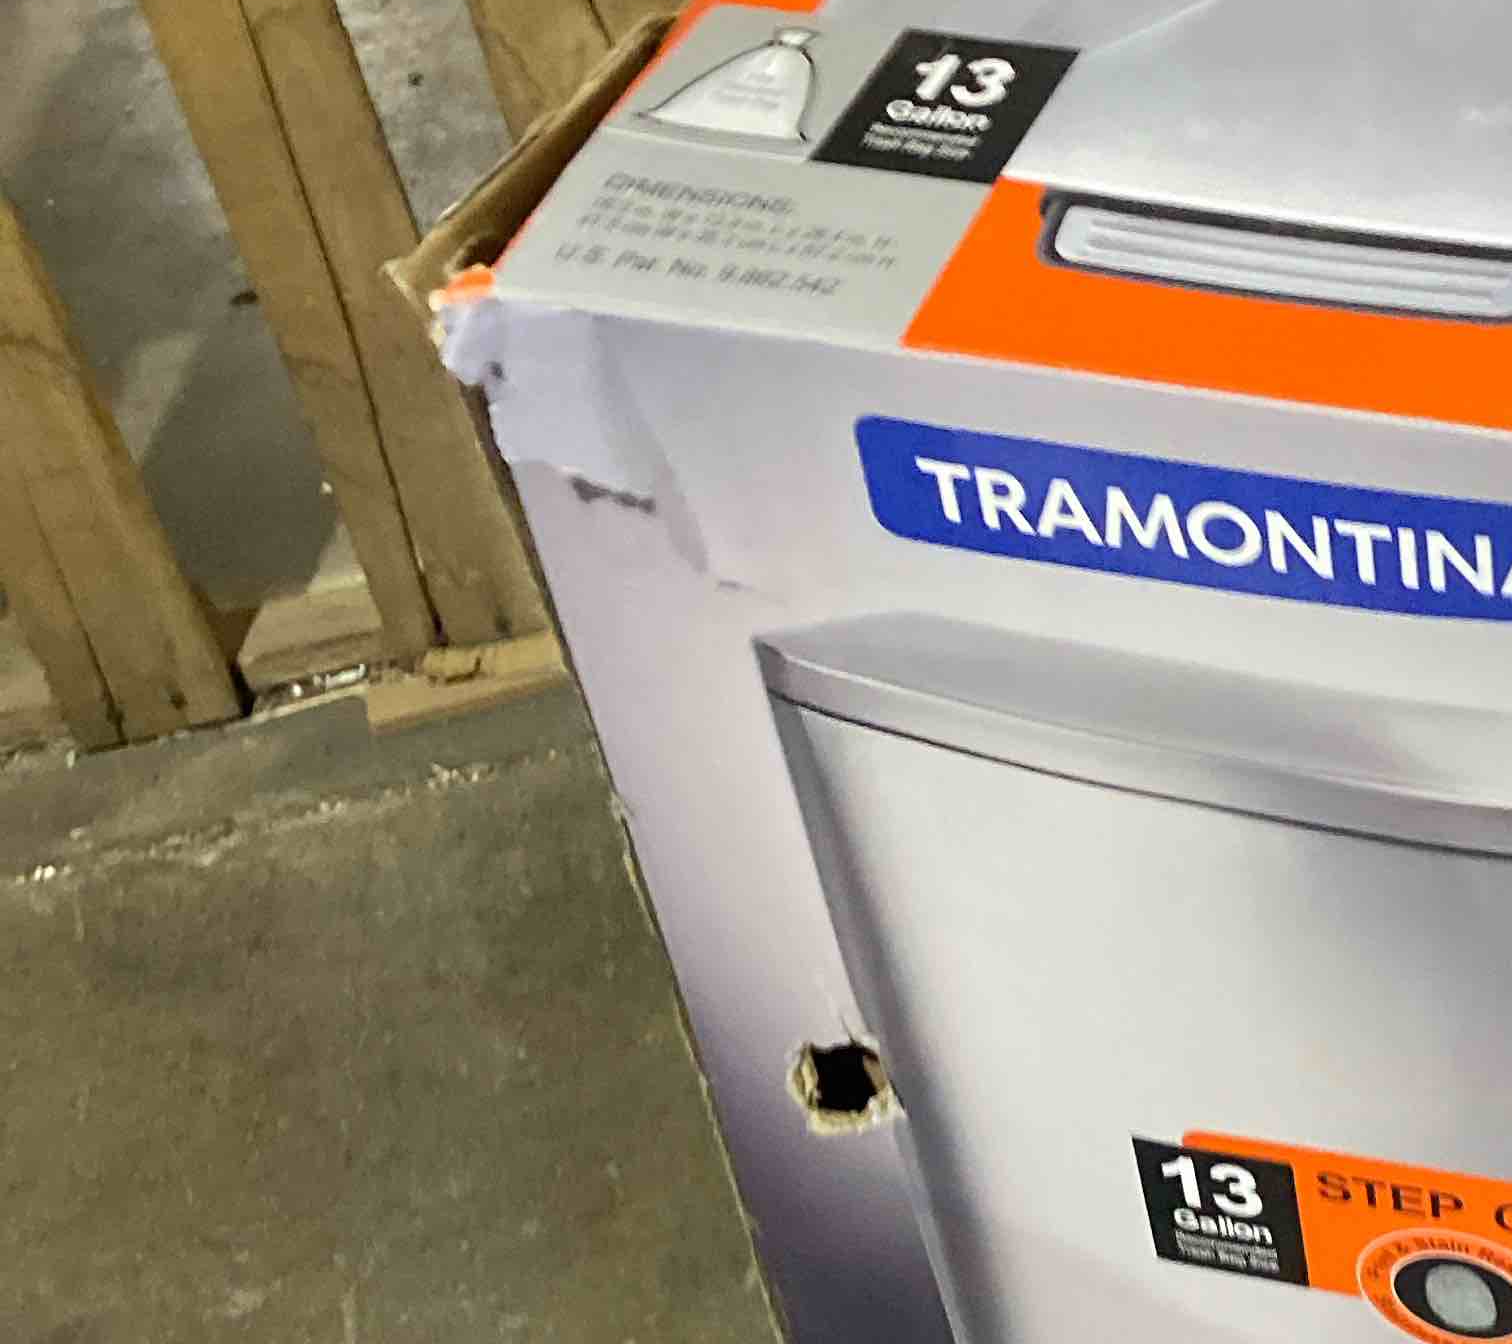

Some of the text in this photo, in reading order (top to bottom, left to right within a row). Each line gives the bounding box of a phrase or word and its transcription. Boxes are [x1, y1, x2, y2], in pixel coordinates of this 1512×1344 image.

[914, 53, 1017, 108] 13
[885, 99, 992, 132] Gallon
[1160, 1154, 1264, 1219] 13
[1316, 1169, 1465, 1223] STEP
[1173, 1207, 1273, 1245] Gallon
